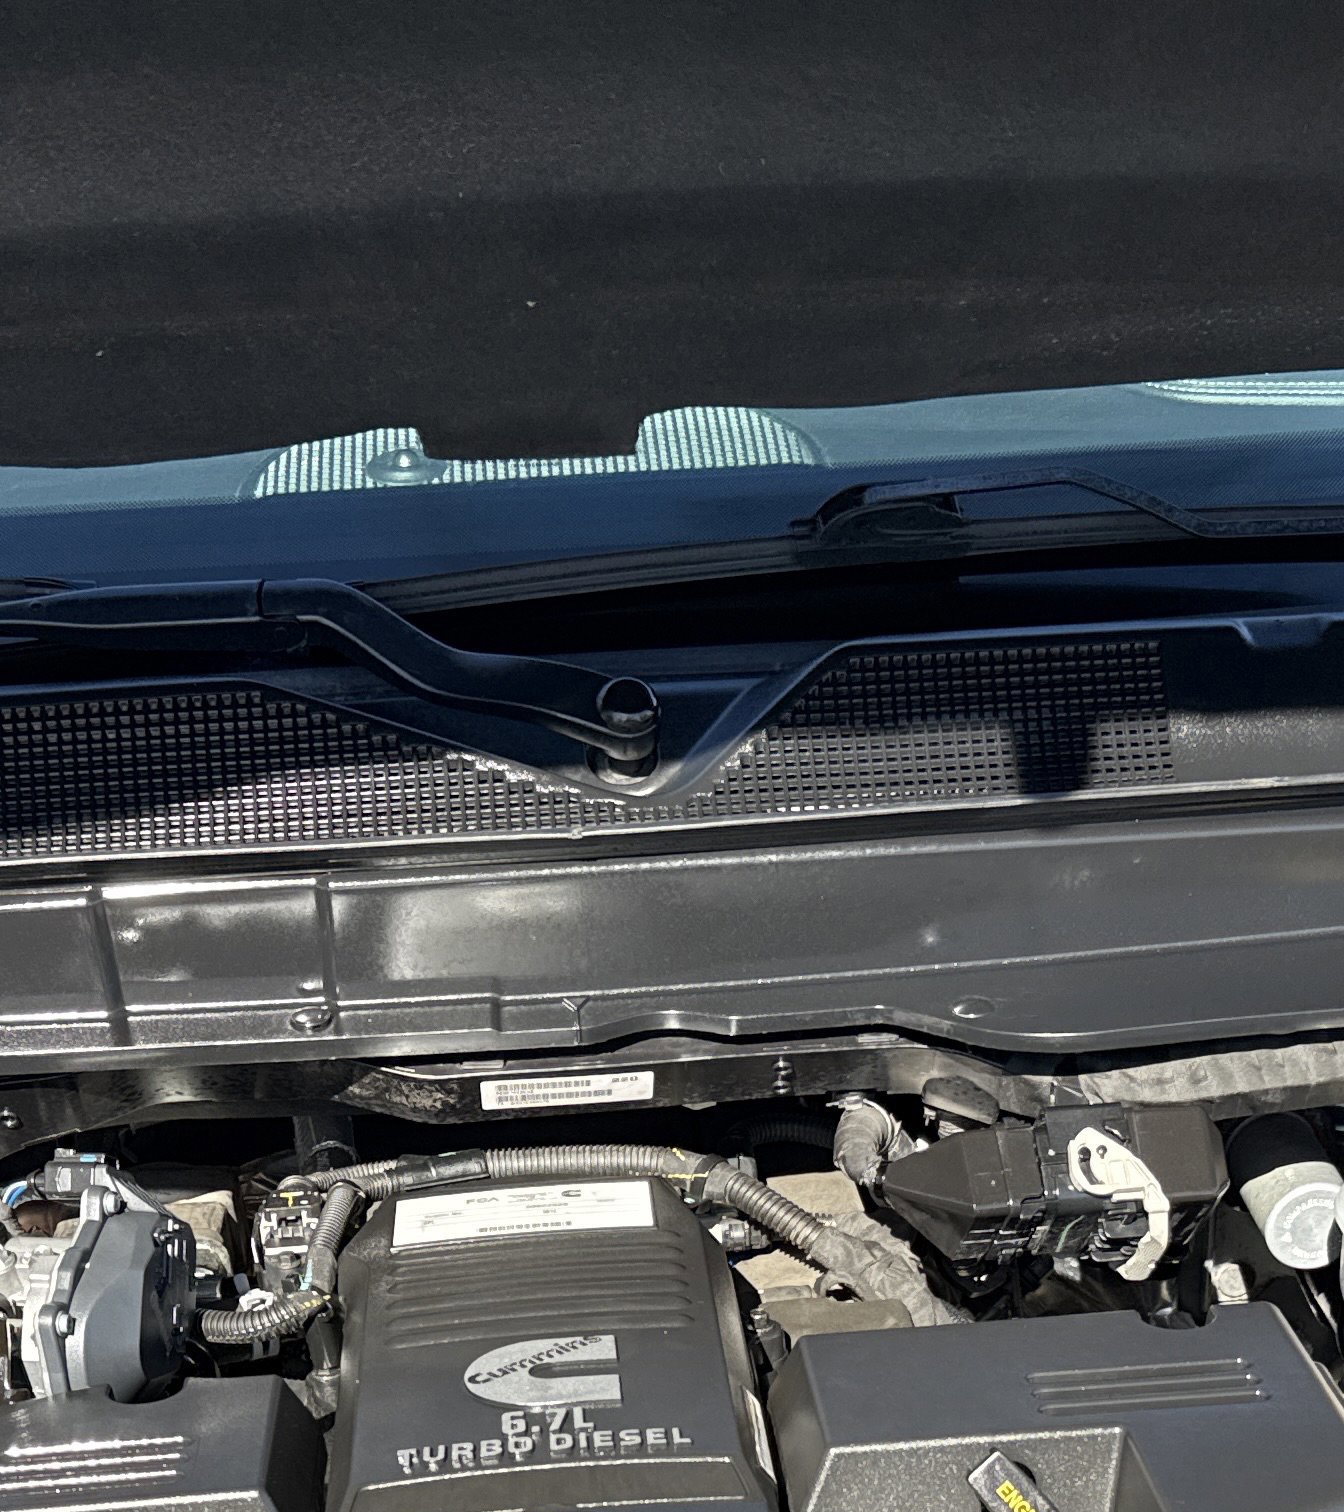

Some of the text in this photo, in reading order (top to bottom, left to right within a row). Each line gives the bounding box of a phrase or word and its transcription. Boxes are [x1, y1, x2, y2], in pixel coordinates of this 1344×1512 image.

[467, 1334, 602, 1385] Cummins
[501, 1407, 595, 1435] 6.7L
[397, 1427, 692, 1467] TURBO DIESEL
